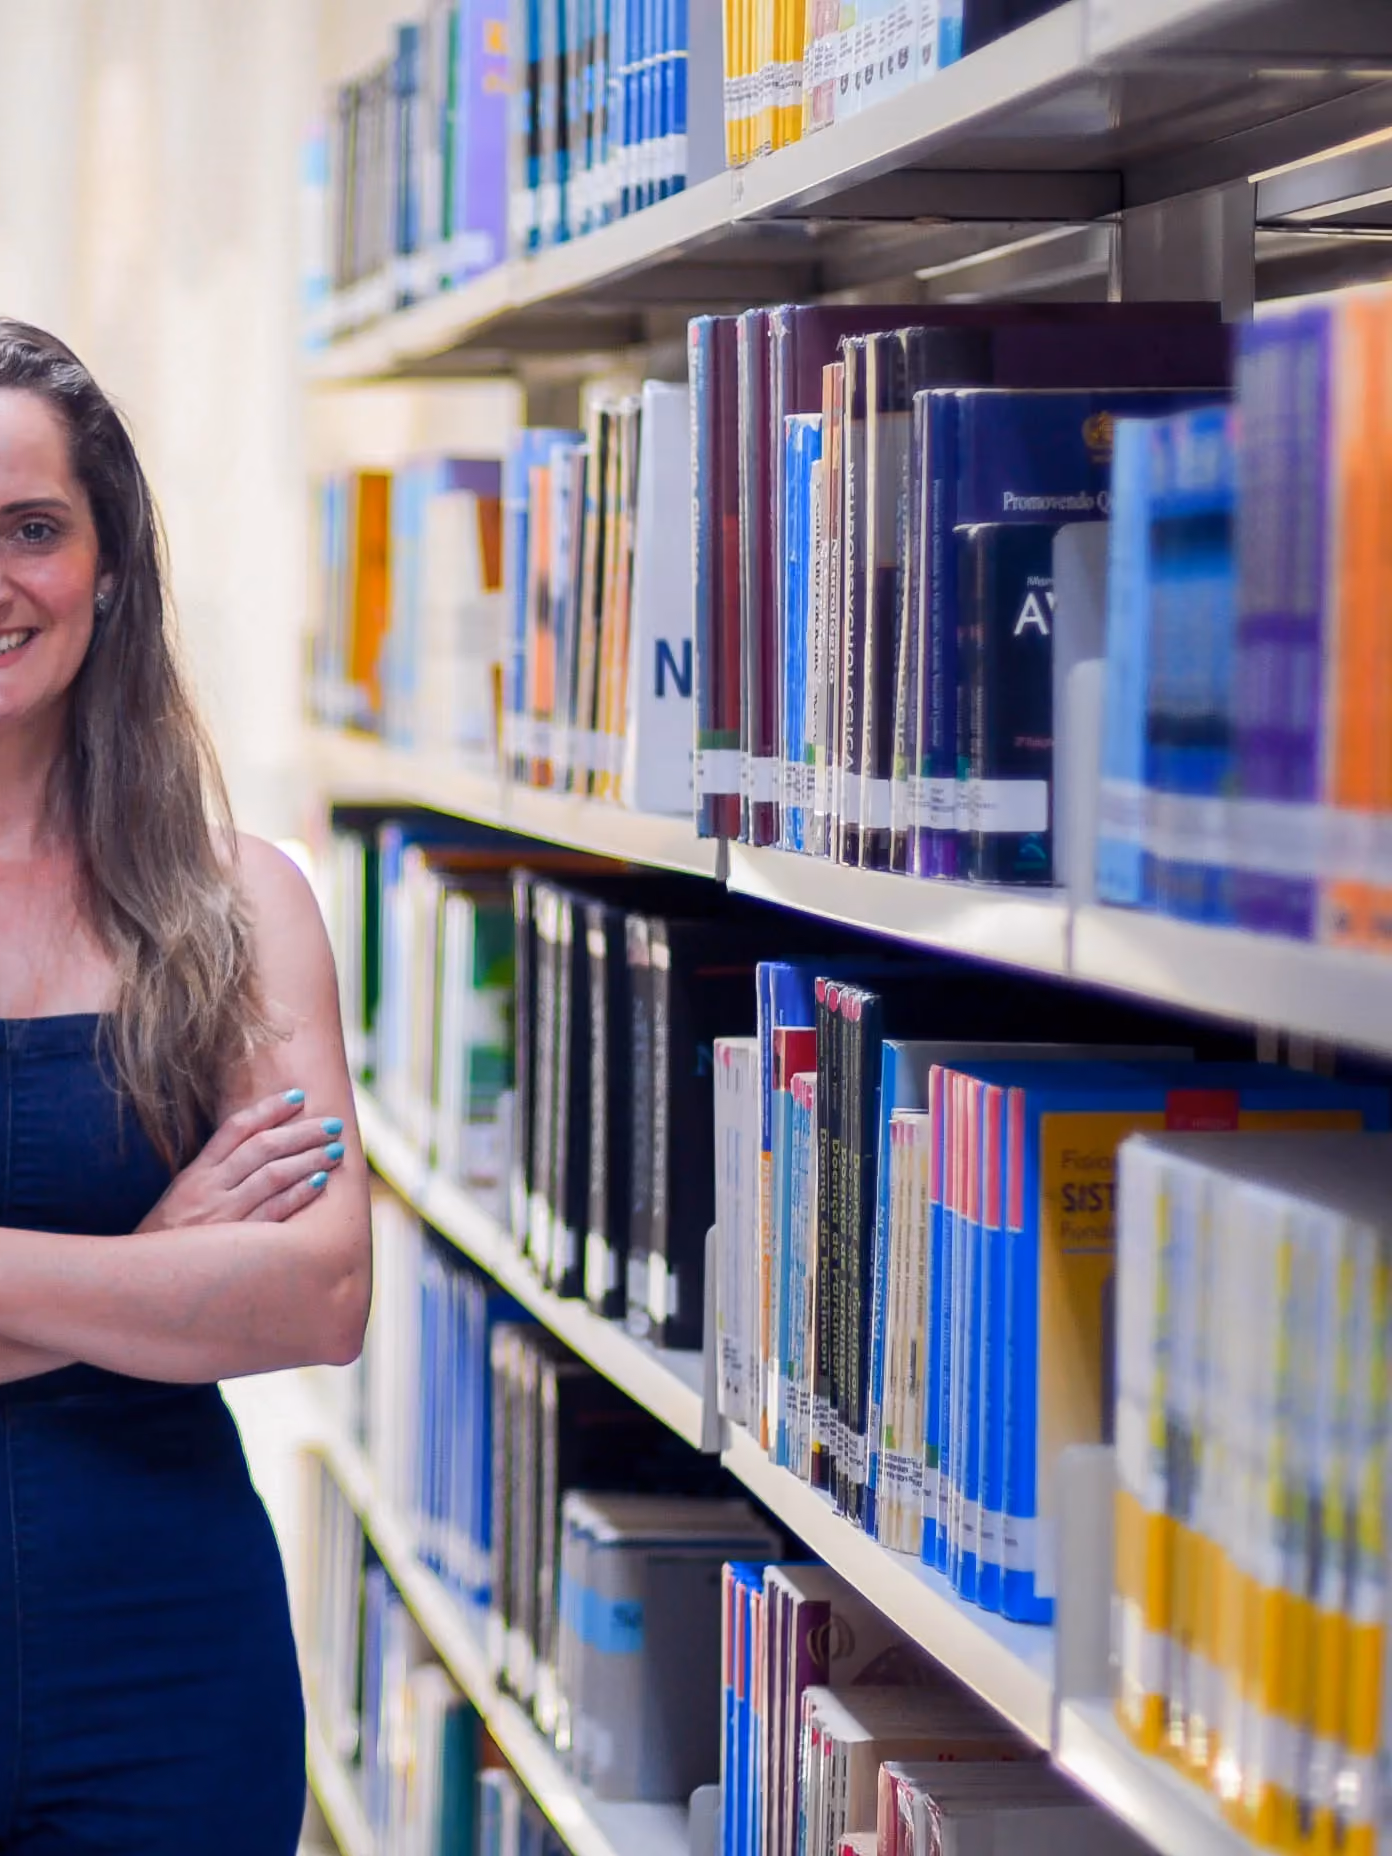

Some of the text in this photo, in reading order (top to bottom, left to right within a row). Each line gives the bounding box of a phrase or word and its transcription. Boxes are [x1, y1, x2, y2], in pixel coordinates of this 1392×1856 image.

[1002, 489, 1112, 514] Promovendo Q
[829, 538, 839, 684] Neurológico
[845, 460, 856, 776] NEUROPSYCHOLOGICA
[831, 1138, 840, 1224] Doença
[851, 1153, 861, 1241] Doença
[1061, 1181, 1120, 1213] SIST
[819, 1127, 829, 1370] Doença de Parkinson
[832, 1268, 840, 1384] Parkinson
[851, 1286, 861, 1407] Parkinson
